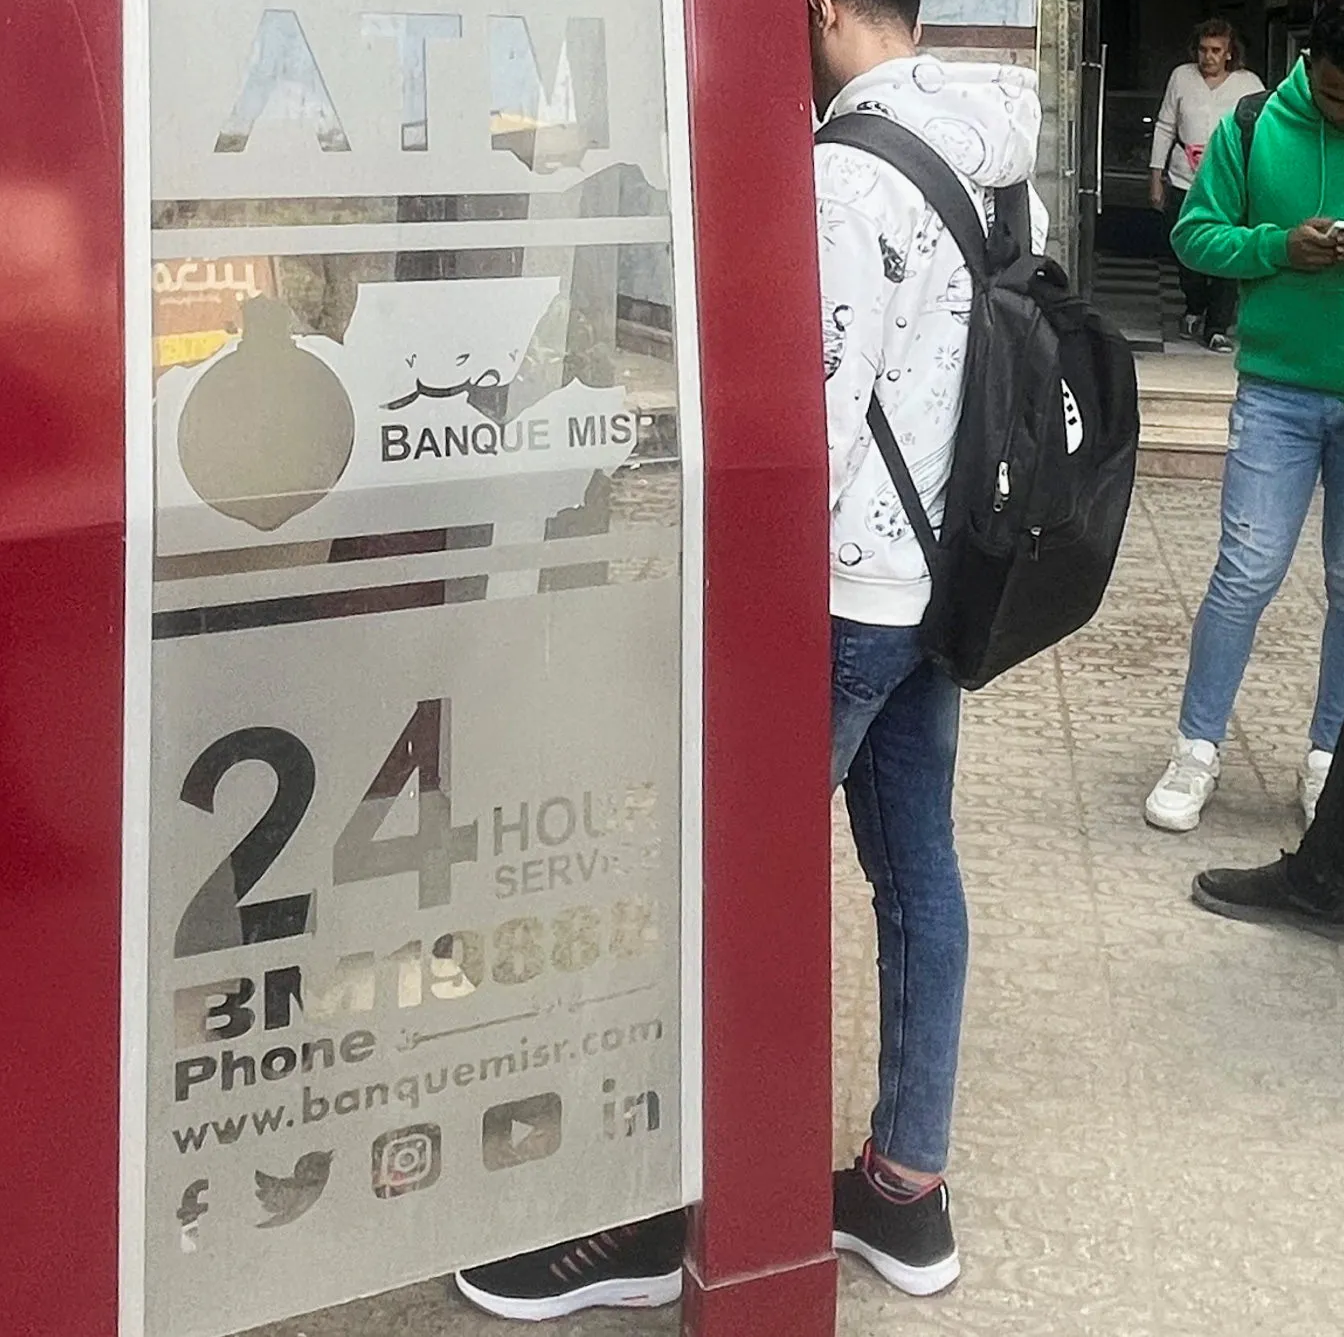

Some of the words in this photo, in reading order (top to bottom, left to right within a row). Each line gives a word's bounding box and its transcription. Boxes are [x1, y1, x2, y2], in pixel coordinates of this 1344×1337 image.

[214, 8, 610, 153] ATM
[380, 418, 551, 463] BANQUE
[173, 697, 478, 959] 24
[171, 1018, 664, 1155] www.banquemisr.com
[173, 1028, 377, 1102] Phone
